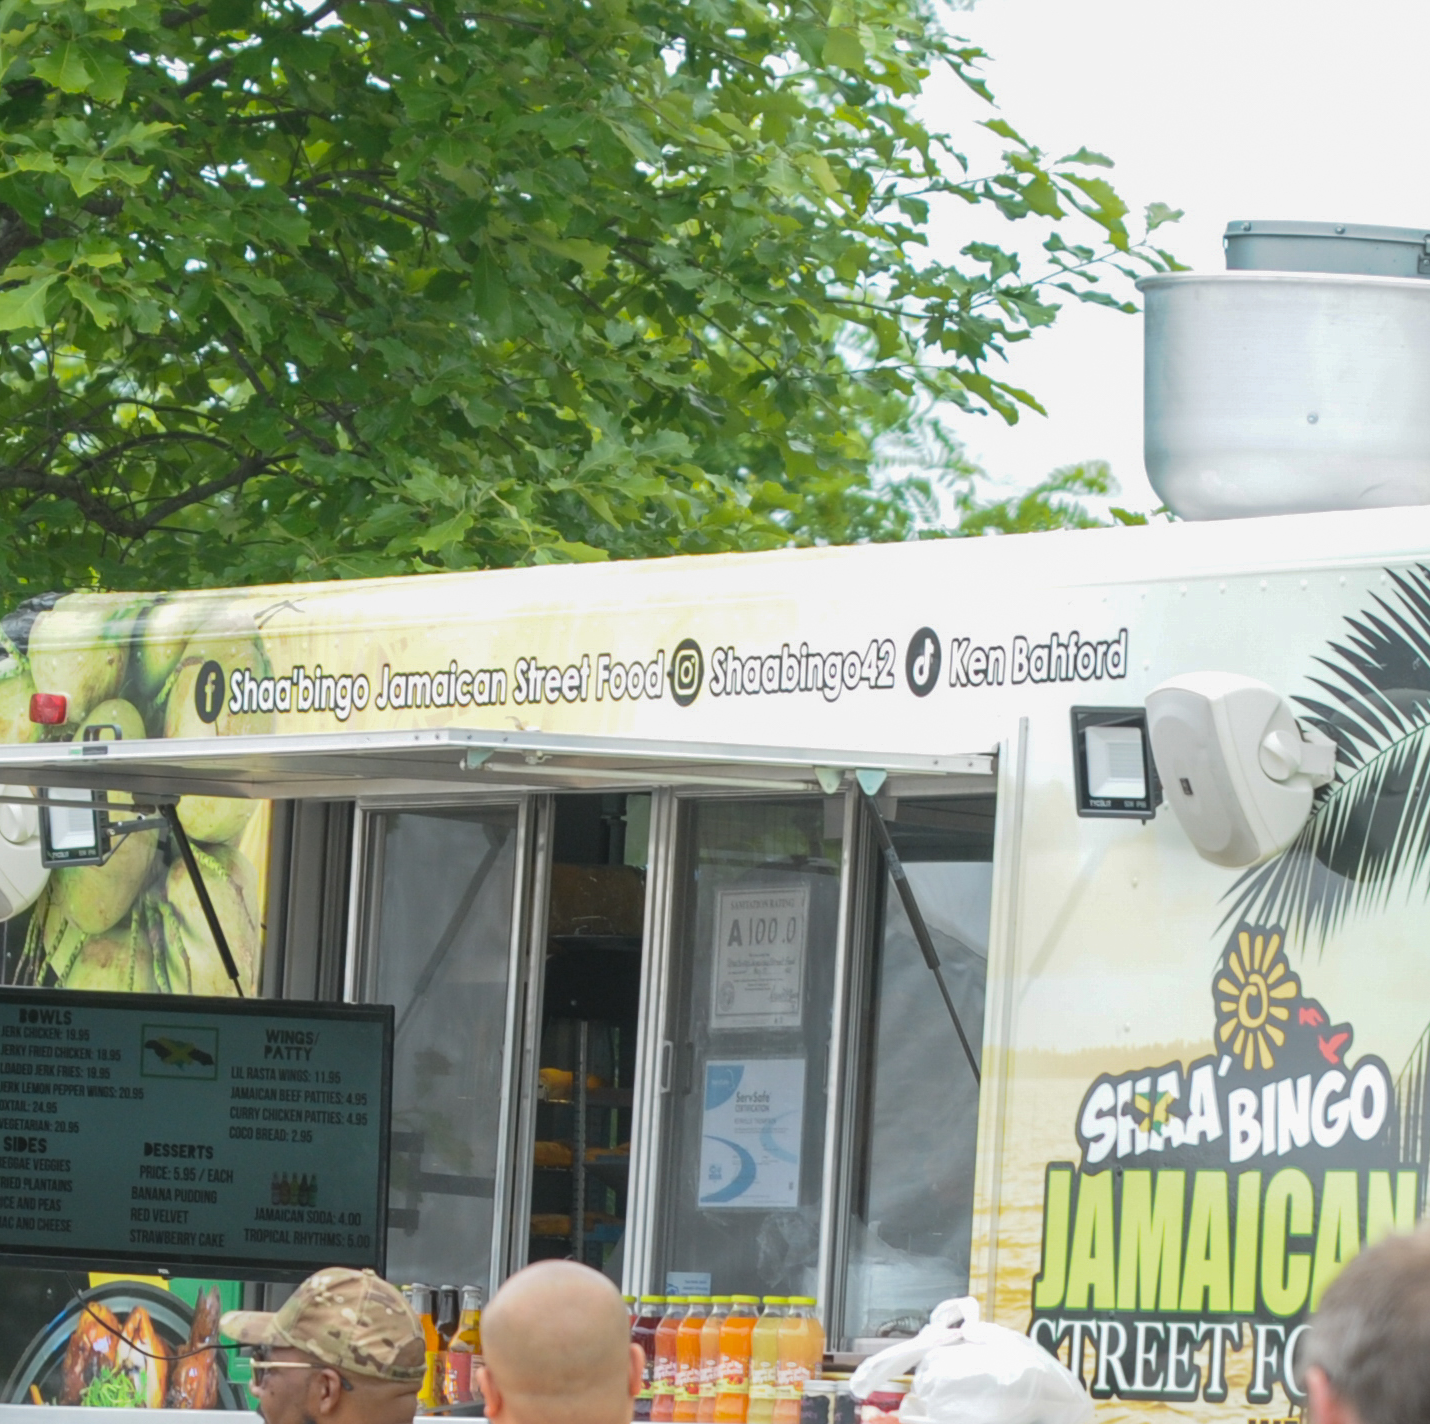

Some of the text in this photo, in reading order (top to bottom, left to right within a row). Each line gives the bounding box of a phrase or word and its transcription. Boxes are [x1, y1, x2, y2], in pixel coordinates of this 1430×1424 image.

[949, 627, 1129, 688] Ken Bahford
[709, 639, 897, 703] Shaabingo42
[228, 650, 666, 721] Shaa'bingo Jamaican Street Food
[727, 919, 742, 947] A
[19, 1008, 72, 1025] BOWLS
[0, 1026, 21, 1038] JERK
[23, 1027, 62, 1040] CHICKEN:
[265, 1029, 320, 1046] WINGS/
[0, 1044, 27, 1057] JERKY
[28, 1046, 53, 1058] FRIED
[264, 1045, 313, 1061] PATTY
[0, 1062, 33, 1075] LOADED
[34, 1064, 55, 1077] JERK
[57, 1065, 84, 1078] FRIES:
[231, 1066, 341, 1084] LIL RASTA WINGS: 11.95
[0, 1081, 20, 1093] JERK
[22, 1082, 51, 1095] LEMON
[52, 1083, 85, 1097] PEPPER
[230, 1087, 277, 1101] JAMAICAN
[279, 1089, 302, 1102] BEEF
[735, 1091, 770, 1103] ServSafe
[32, 1101, 58, 1114] 24.95
[230, 1106, 261, 1120] CURRY
[262, 1108, 302, 1123] CHICKEN
[346, 1112, 368, 1126] 4.95
[229, 1126, 313, 1143] COCO BREAD: 2.95
[3, 1136, 48, 1154] SIDES
[143, 1142, 214, 1160] DESSERTS
[33, 1158, 71, 1173] VEGGIES
[139, 1165, 171, 1180] PRICE:
[173, 1166, 196, 1182] 5.95
[207, 1169, 234, 1184] EACH
[23, 1177, 73, 1193] PLANTAINS
[131, 1186, 218, 1205] BANANA PUDDING
[16, 1197, 36, 1210] AND
[38, 1198, 61, 1212] PEAS
[130, 1207, 189, 1224] RED VELVET
[254, 1207, 362, 1227] JAMAICAN SODA: 4.00
[16, 1216, 35, 1230] AND
[37, 1218, 71, 1233] CHEESE
[129, 1229, 225, 1248] STRAWBERRY CAKE
[244, 1228, 291, 1245] TROPICAL
[293, 1231, 345, 1247] RHYTHMS:
